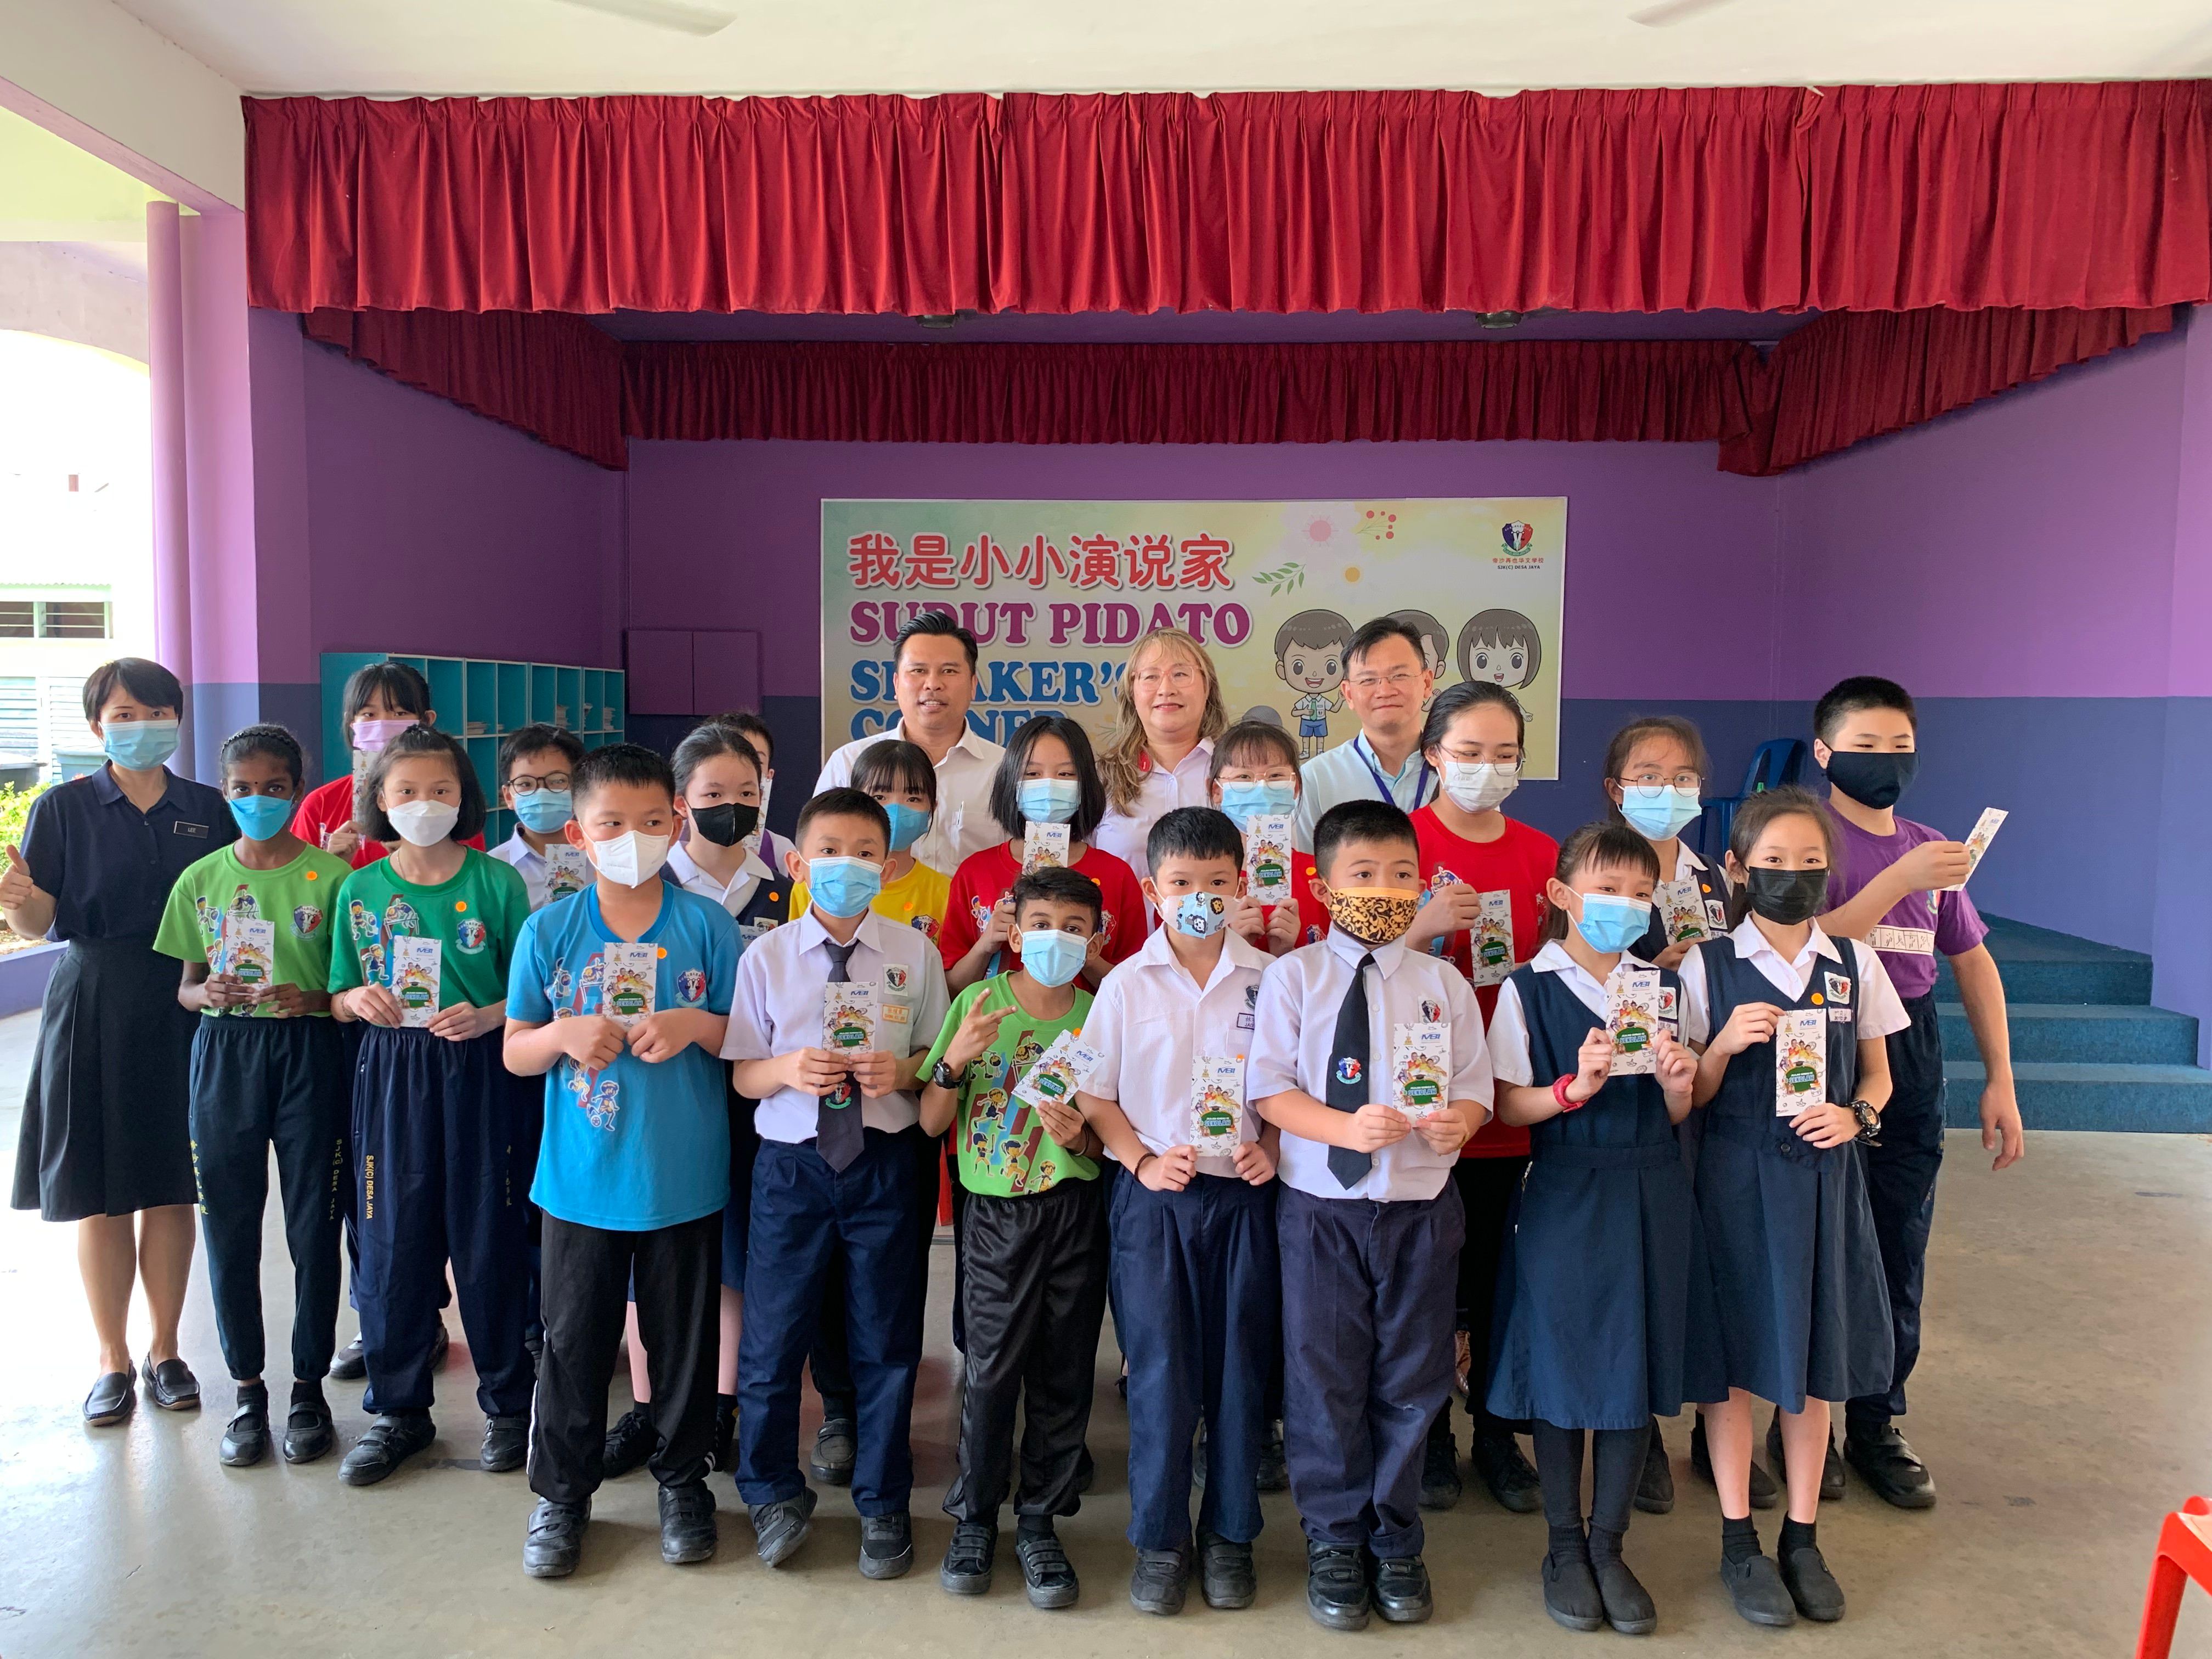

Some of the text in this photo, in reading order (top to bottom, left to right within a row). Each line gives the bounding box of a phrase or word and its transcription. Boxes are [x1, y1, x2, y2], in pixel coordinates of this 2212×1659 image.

[849, 532, 1233, 588] 我是小小演说家
[850, 601, 1250, 646] SUUT PIDATO
[1678, 887, 1691, 895] MBI
[1619, 1035, 1647, 1044] SEKOLAH
[1076, 1050, 1093, 1062] MBI
[1788, 1074, 1815, 1084] SEKOLAH
[1408, 1088, 1437, 1096] SEKOLAH
[332, 1139, 343, 1166] SJK(C)
[331, 1169, 340, 1192] DESA
[364, 1154, 374, 1220] SJK(C) DESA JAYA
